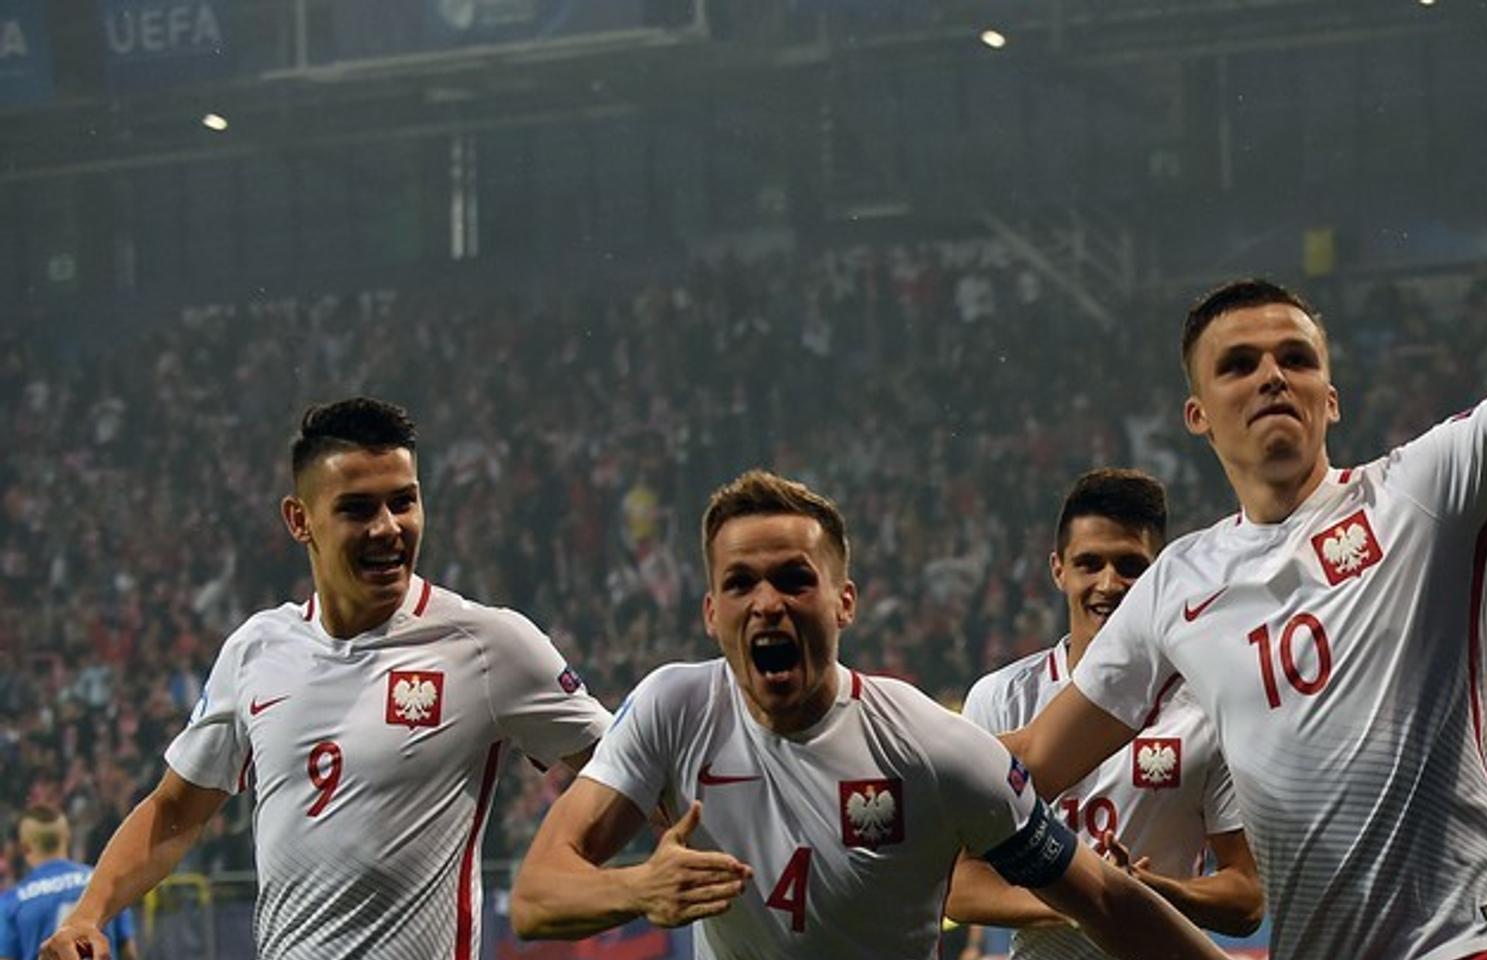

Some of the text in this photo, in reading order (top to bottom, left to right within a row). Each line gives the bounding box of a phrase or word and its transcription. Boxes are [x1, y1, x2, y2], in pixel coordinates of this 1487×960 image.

[106, 2, 223, 53] UEFA
[1246, 612, 1332, 709] 10
[306, 741, 343, 817] 9
[765, 846, 813, 933] 4
